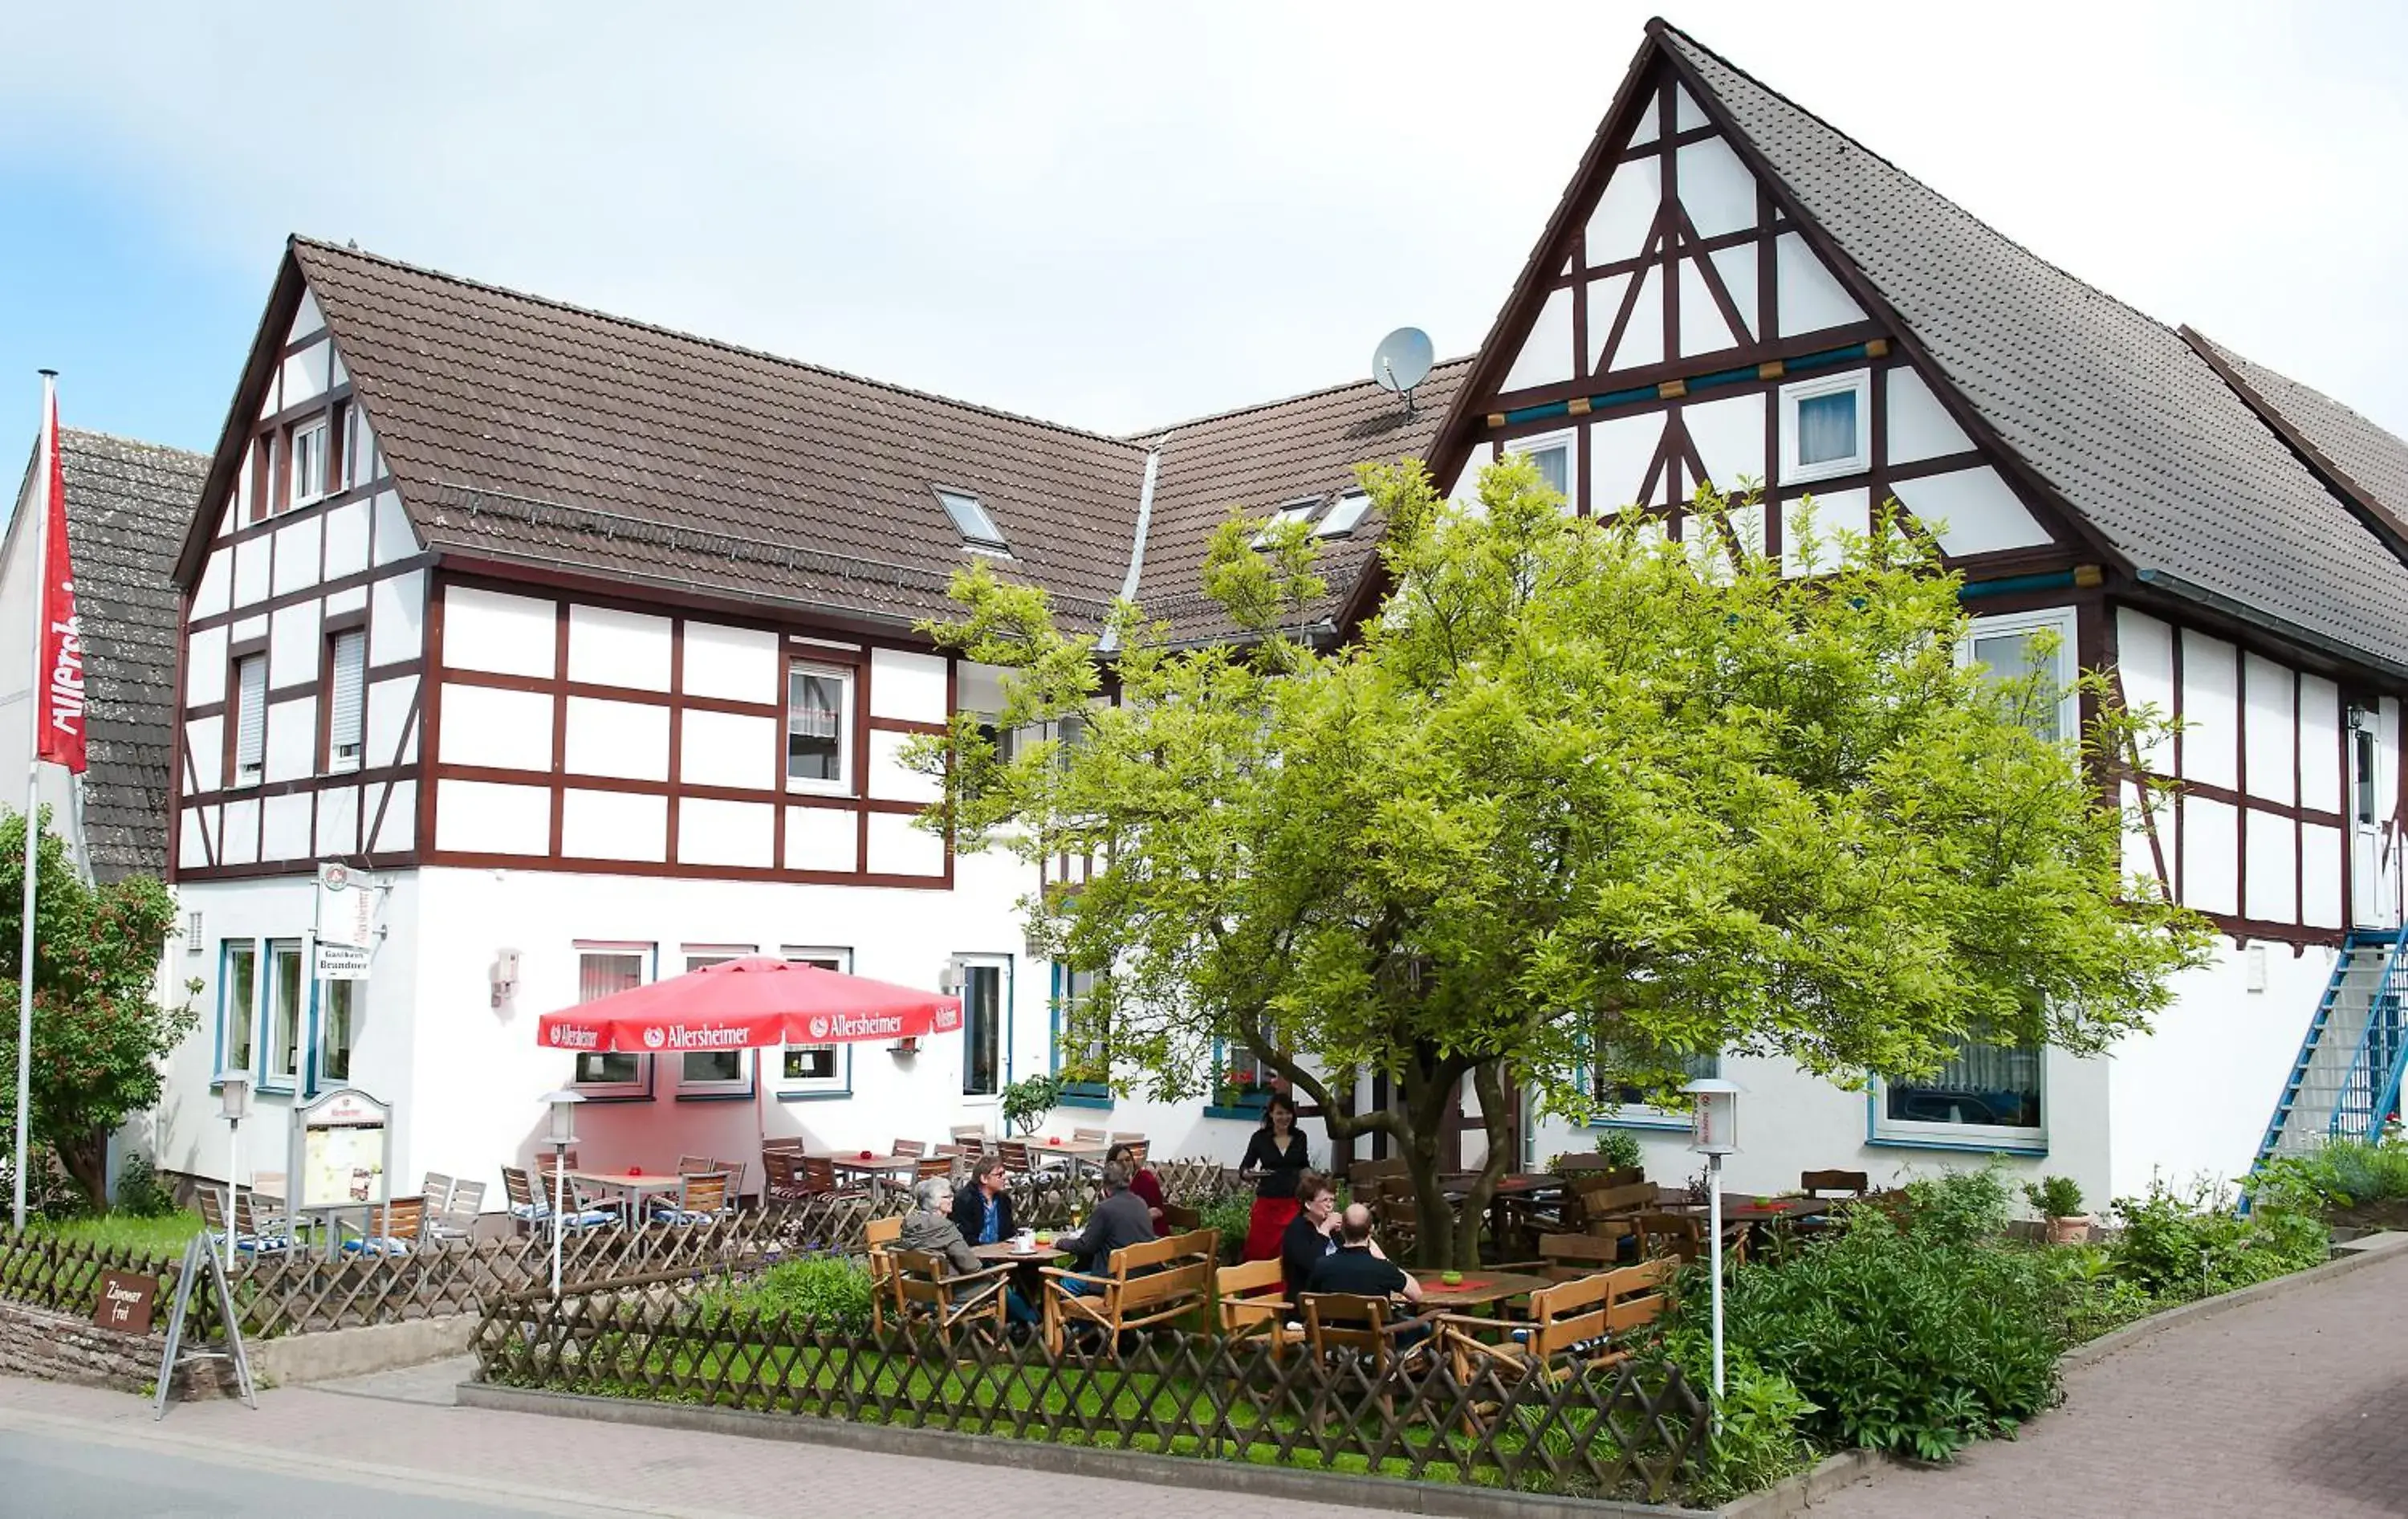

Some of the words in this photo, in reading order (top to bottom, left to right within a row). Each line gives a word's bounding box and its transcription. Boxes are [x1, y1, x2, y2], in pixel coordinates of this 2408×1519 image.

[667, 1023, 750, 1048] Allersheimer
[831, 1012, 902, 1036] Allersheimer
[112, 1300, 128, 1324] frei
